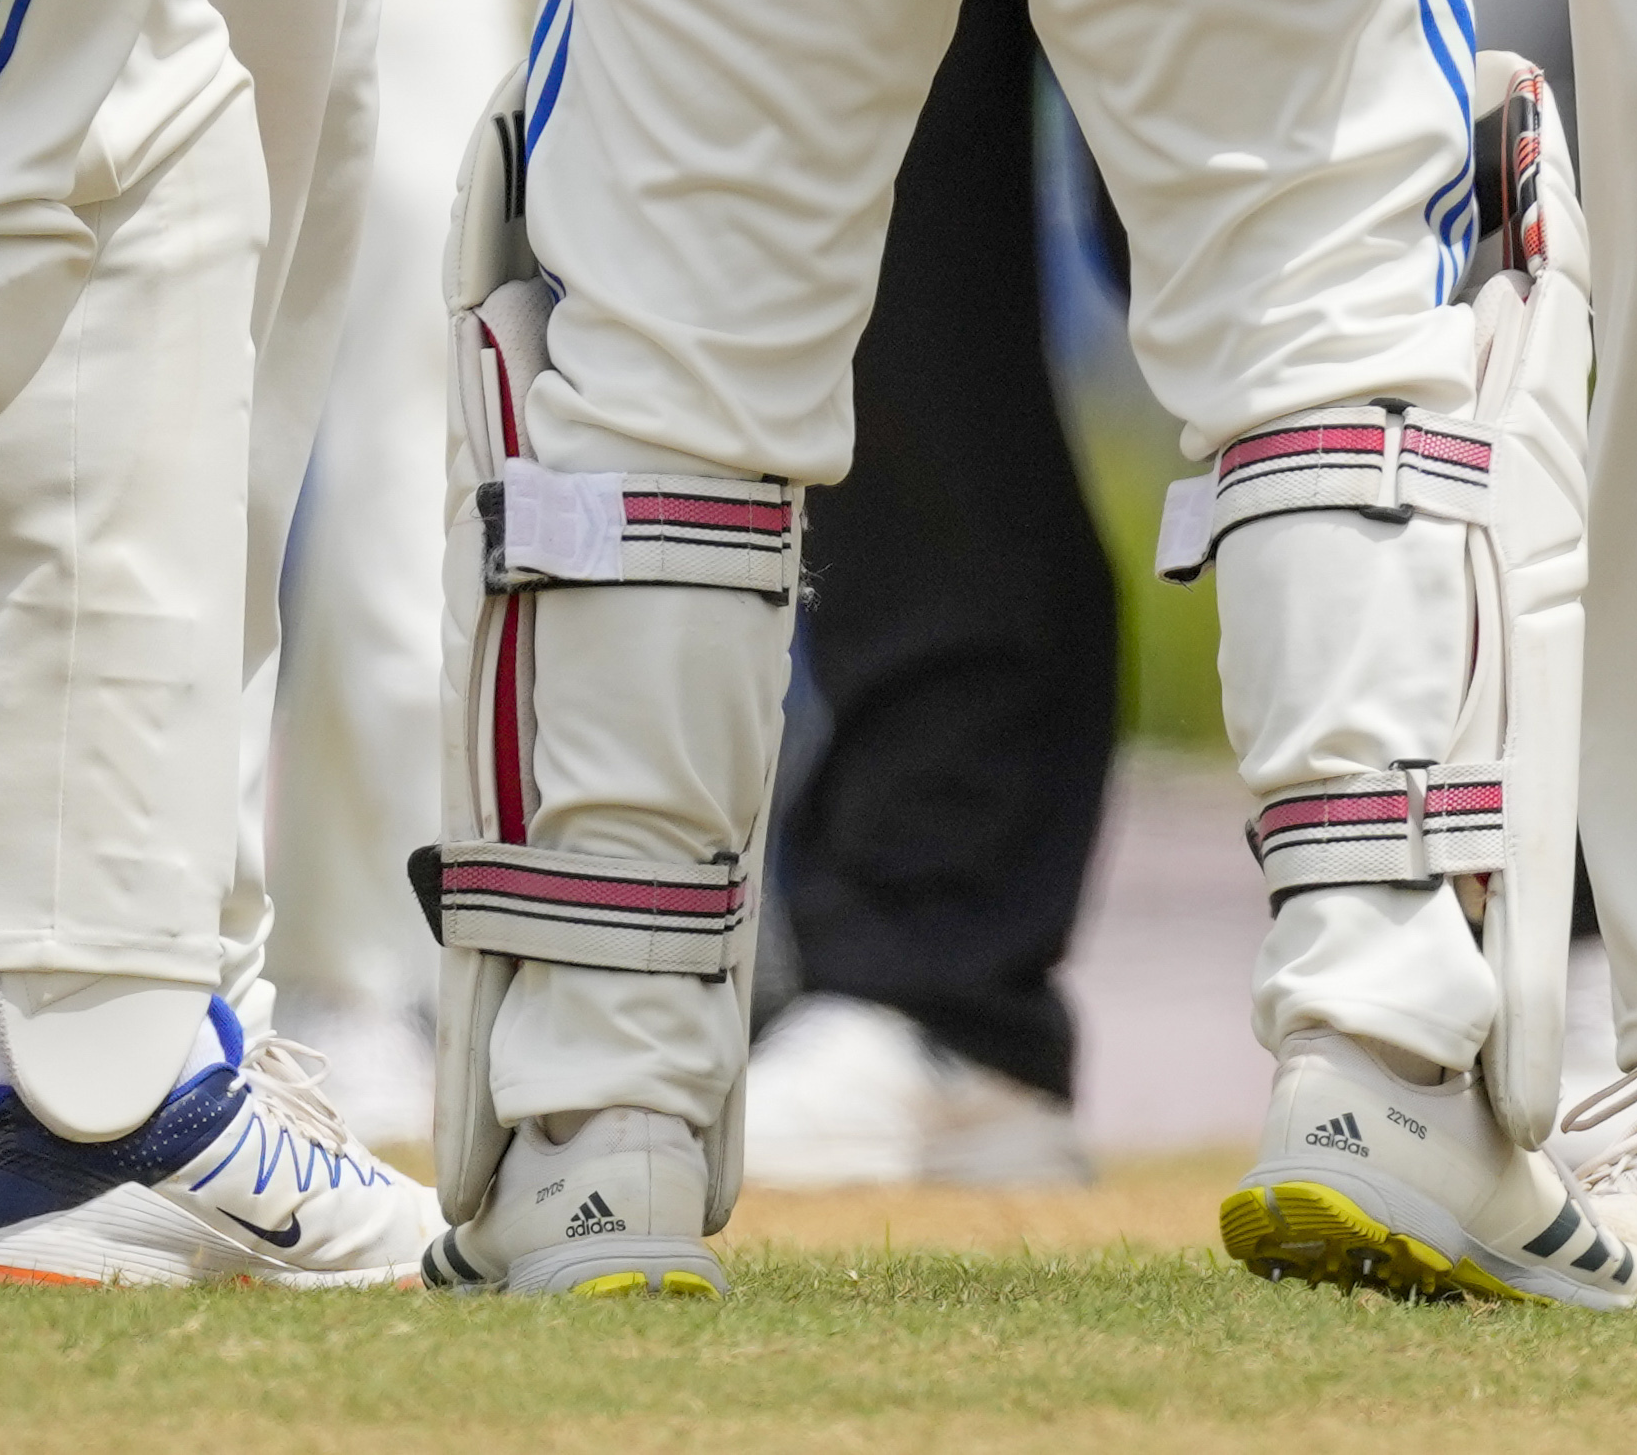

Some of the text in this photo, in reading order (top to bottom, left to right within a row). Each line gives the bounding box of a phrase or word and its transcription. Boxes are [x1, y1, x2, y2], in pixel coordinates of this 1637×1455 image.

[1386, 1106, 1429, 1141] 22YDS
[1305, 1132, 1371, 1158] adidas
[565, 1217, 627, 1239] adidas
